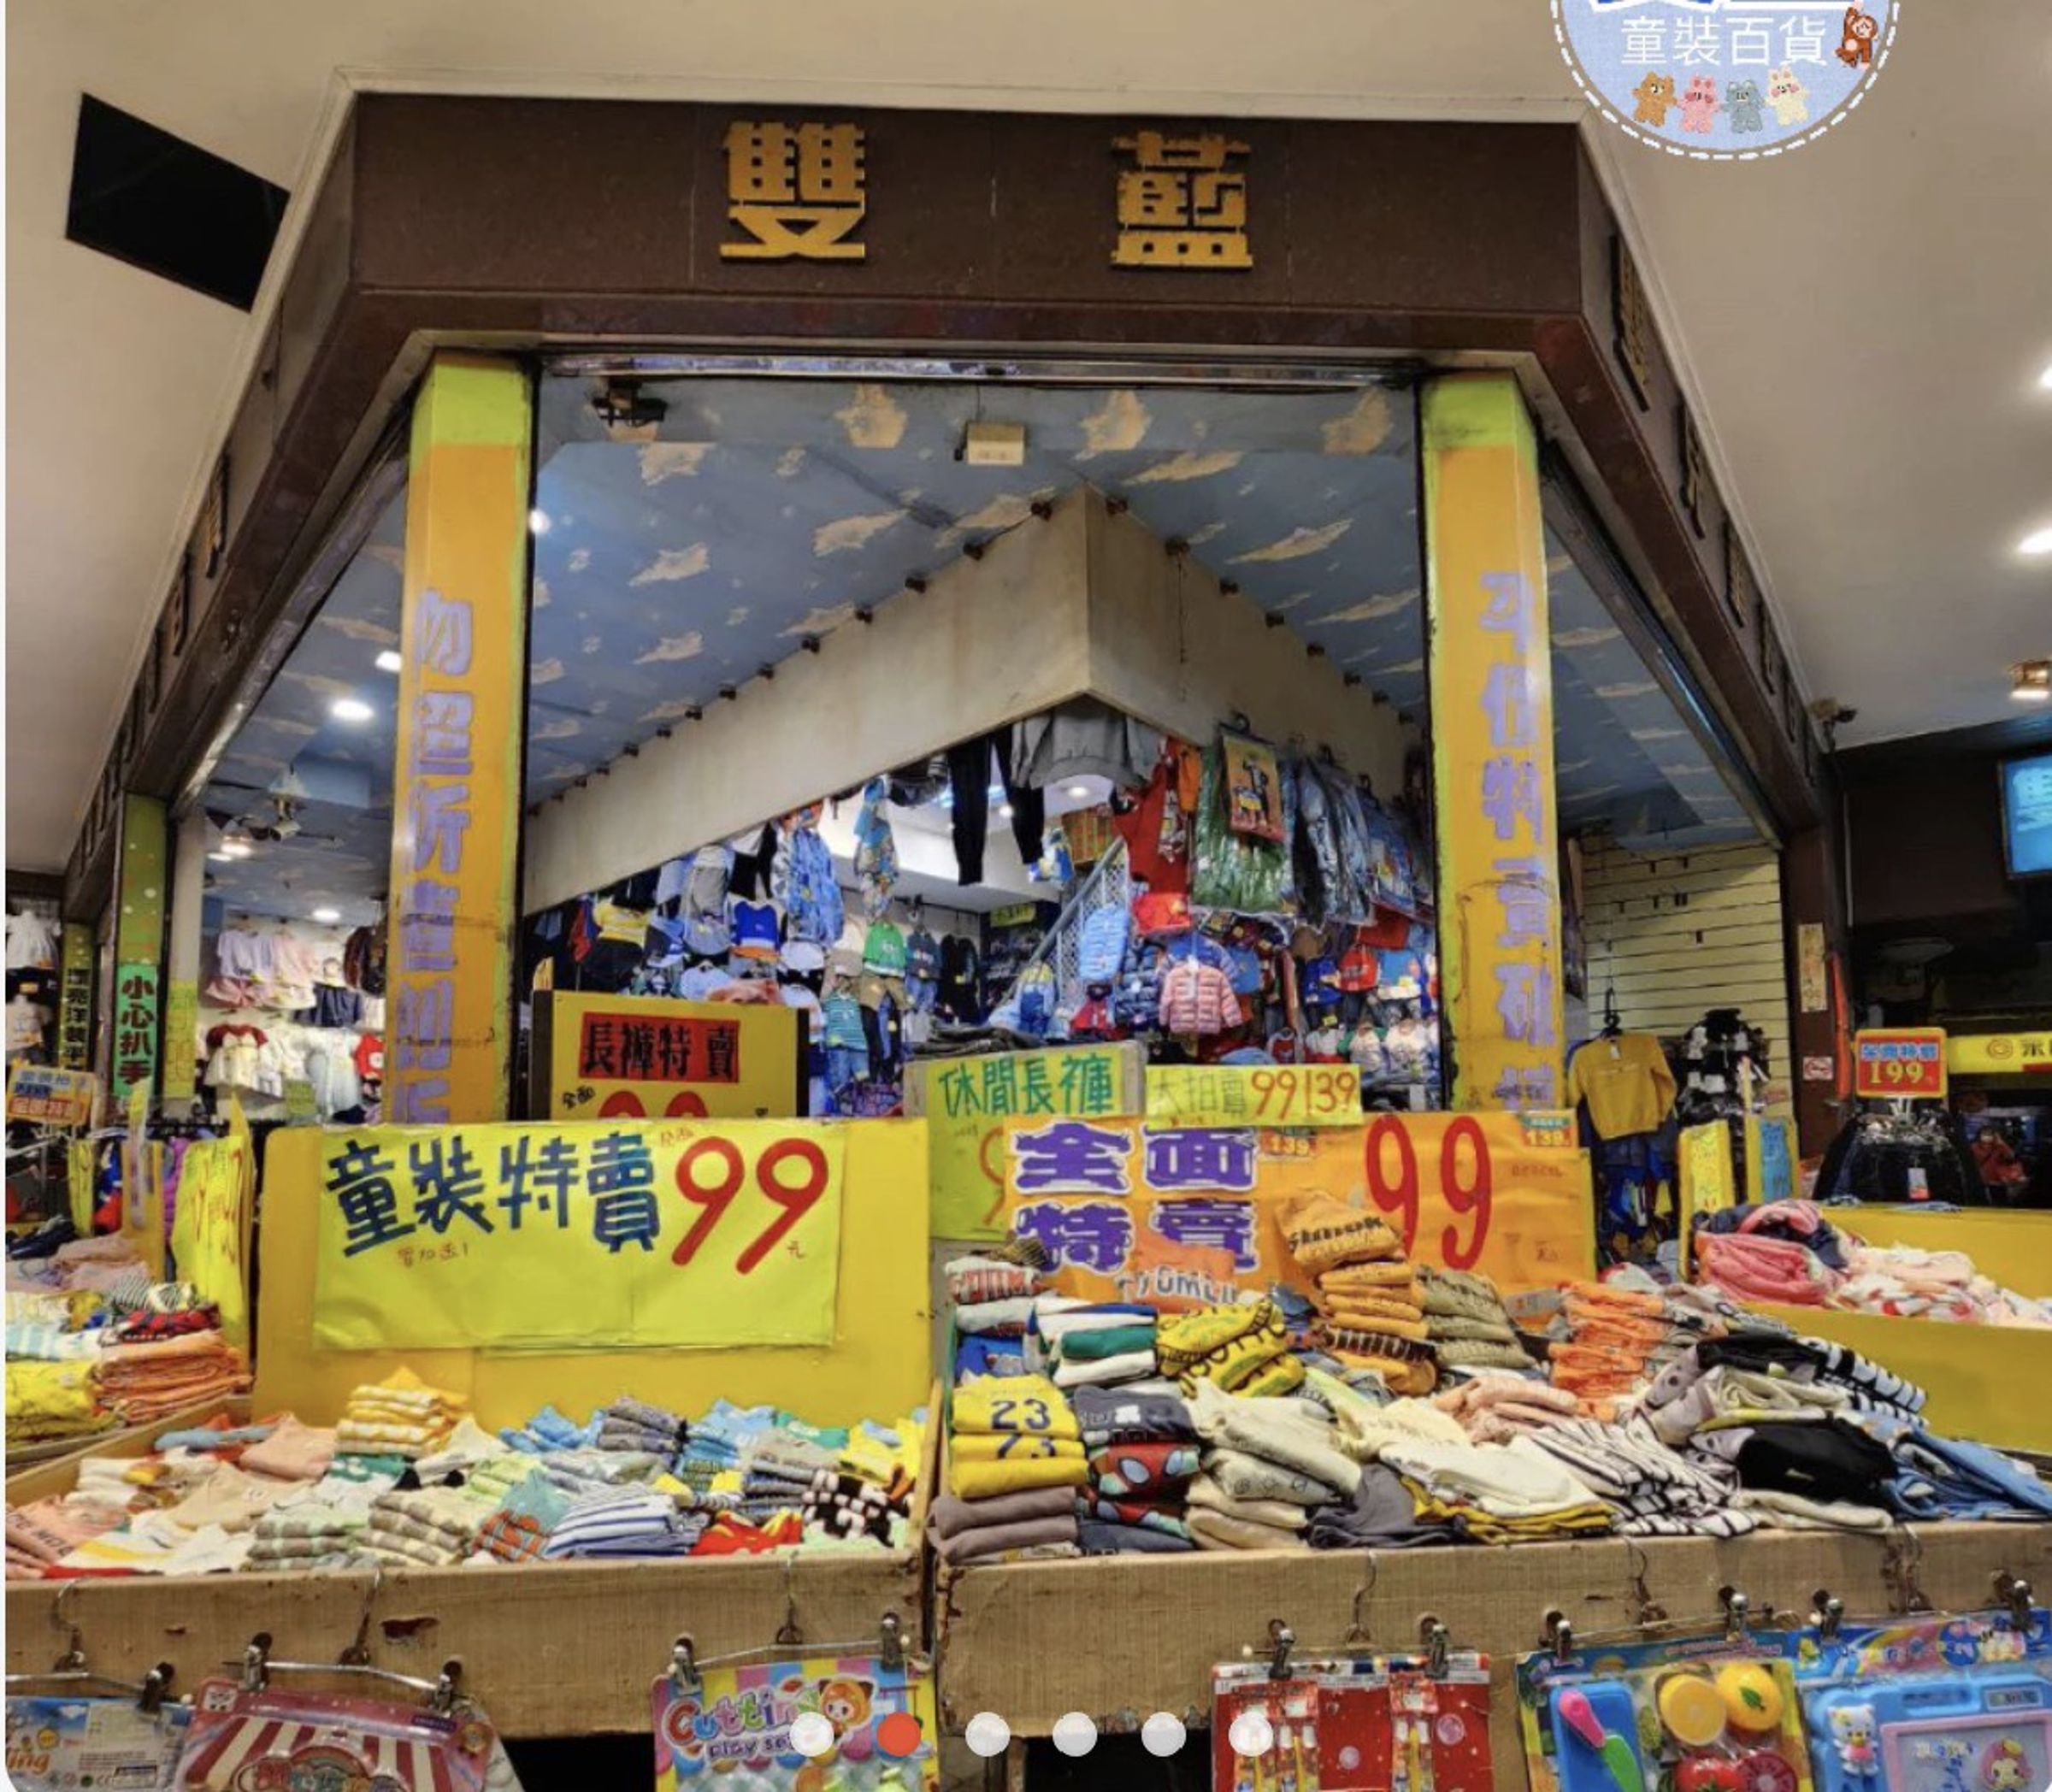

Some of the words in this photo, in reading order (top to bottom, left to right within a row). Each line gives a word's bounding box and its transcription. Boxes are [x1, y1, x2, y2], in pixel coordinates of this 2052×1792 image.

[720, 121, 1253, 268] 雙藍
[118, 976, 155, 1085] 小心扒手
[585, 1022, 734, 1079] 長褲特賣
[1153, 1070, 1247, 1118] 大拍賣
[1251, 1070, 1298, 1121] 99
[1870, 1060, 1924, 1084] 199
[1012, 1121, 1264, 1194] 全面
[327, 1130, 661, 1257] 童裝特賣
[671, 1135, 829, 1276] 99
[1366, 1114, 1491, 1270] 99
[990, 1397, 1052, 1430] 23
[709, 1736, 757, 1758] play
[764, 1729, 792, 1751] se
